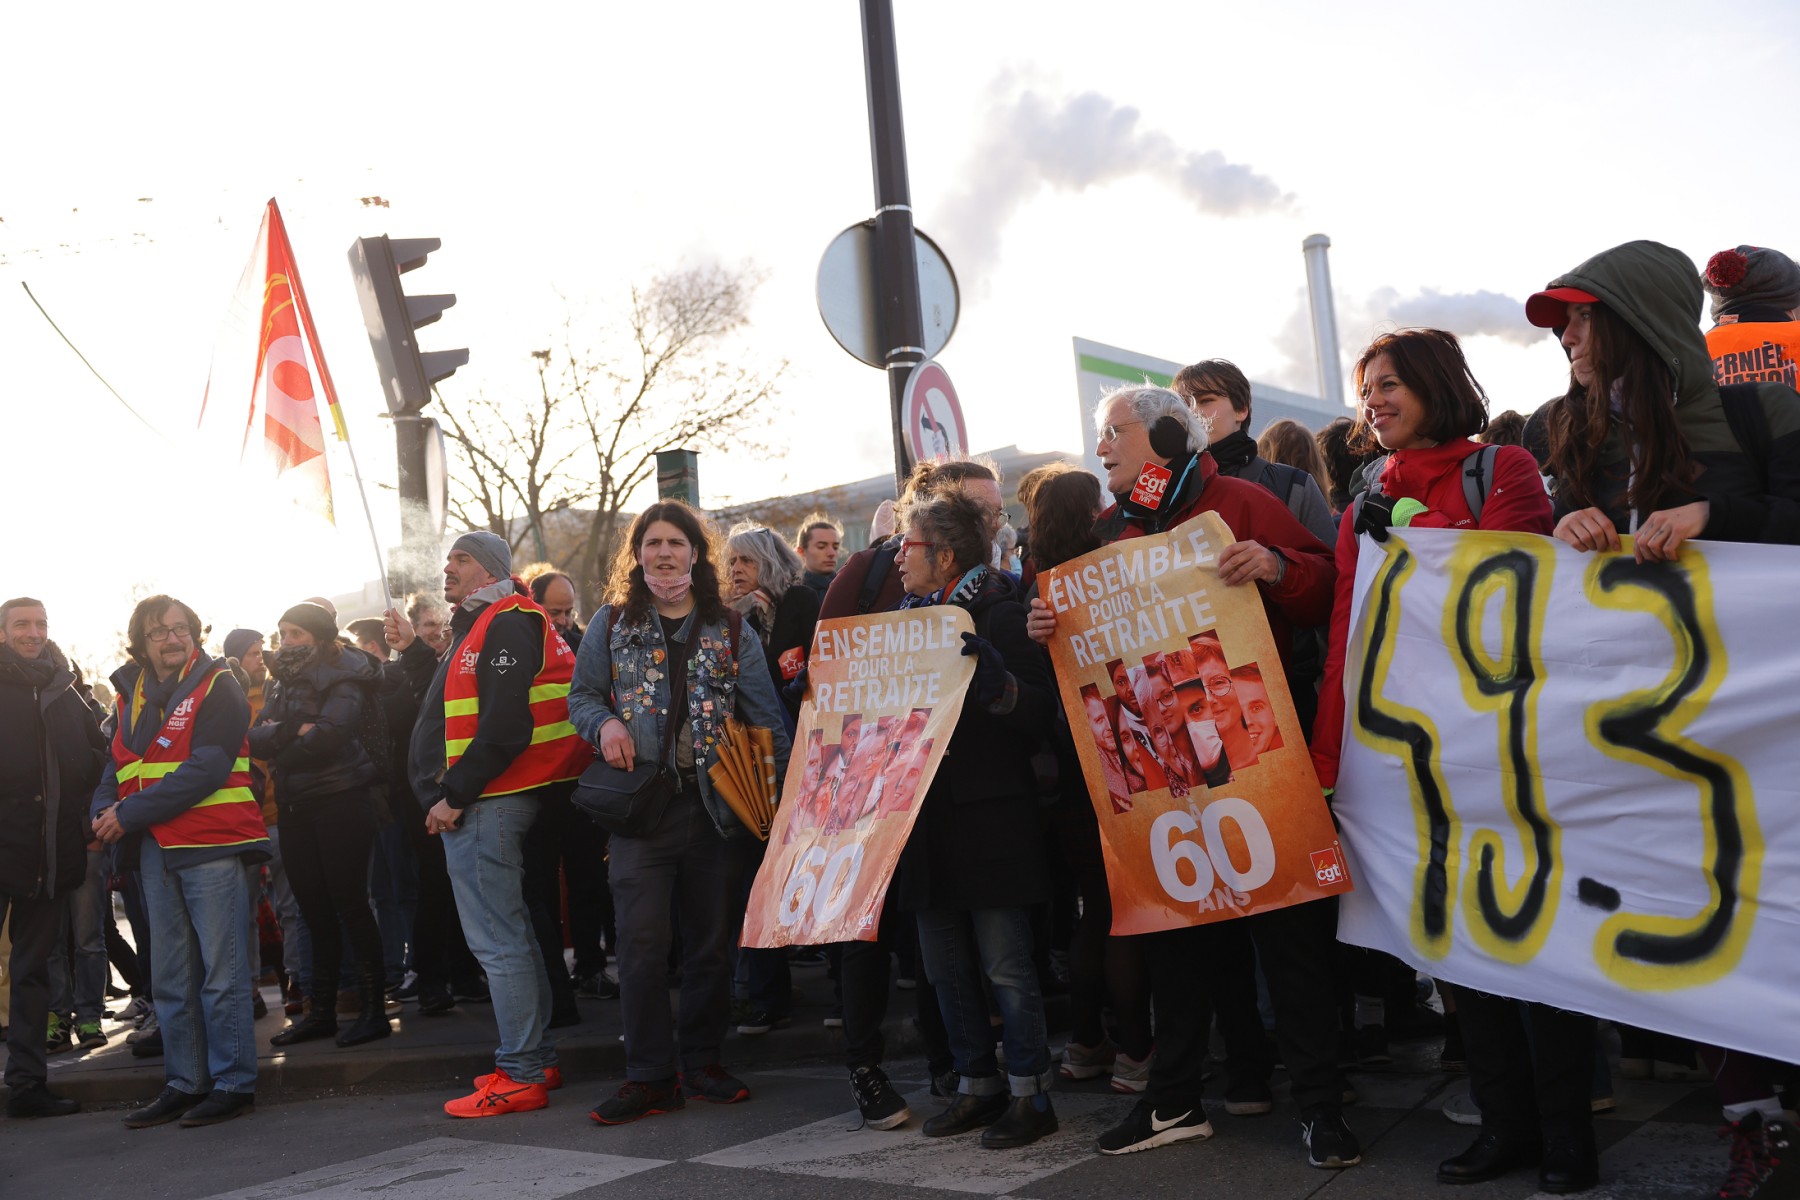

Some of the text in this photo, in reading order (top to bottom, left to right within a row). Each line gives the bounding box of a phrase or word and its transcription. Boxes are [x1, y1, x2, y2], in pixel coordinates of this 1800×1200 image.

[1138, 474, 1168, 494] cgt
[1050, 528, 1214, 614] ENSEMBLE
[1089, 581, 1166, 625] POUR LA
[817, 615, 957, 662] ENSEMBLE
[1069, 589, 1217, 668] RETRAITE
[848, 655, 914, 679] POUR LA
[173, 697, 194, 717] gt
[816, 672, 941, 713] RETRAITE
[1356, 543, 1753, 978] 49.3
[1149, 797, 1276, 903] 60
[780, 843, 864, 927] 60
[1317, 863, 1342, 882] cgt
[1198, 886, 1252, 914] ANS
